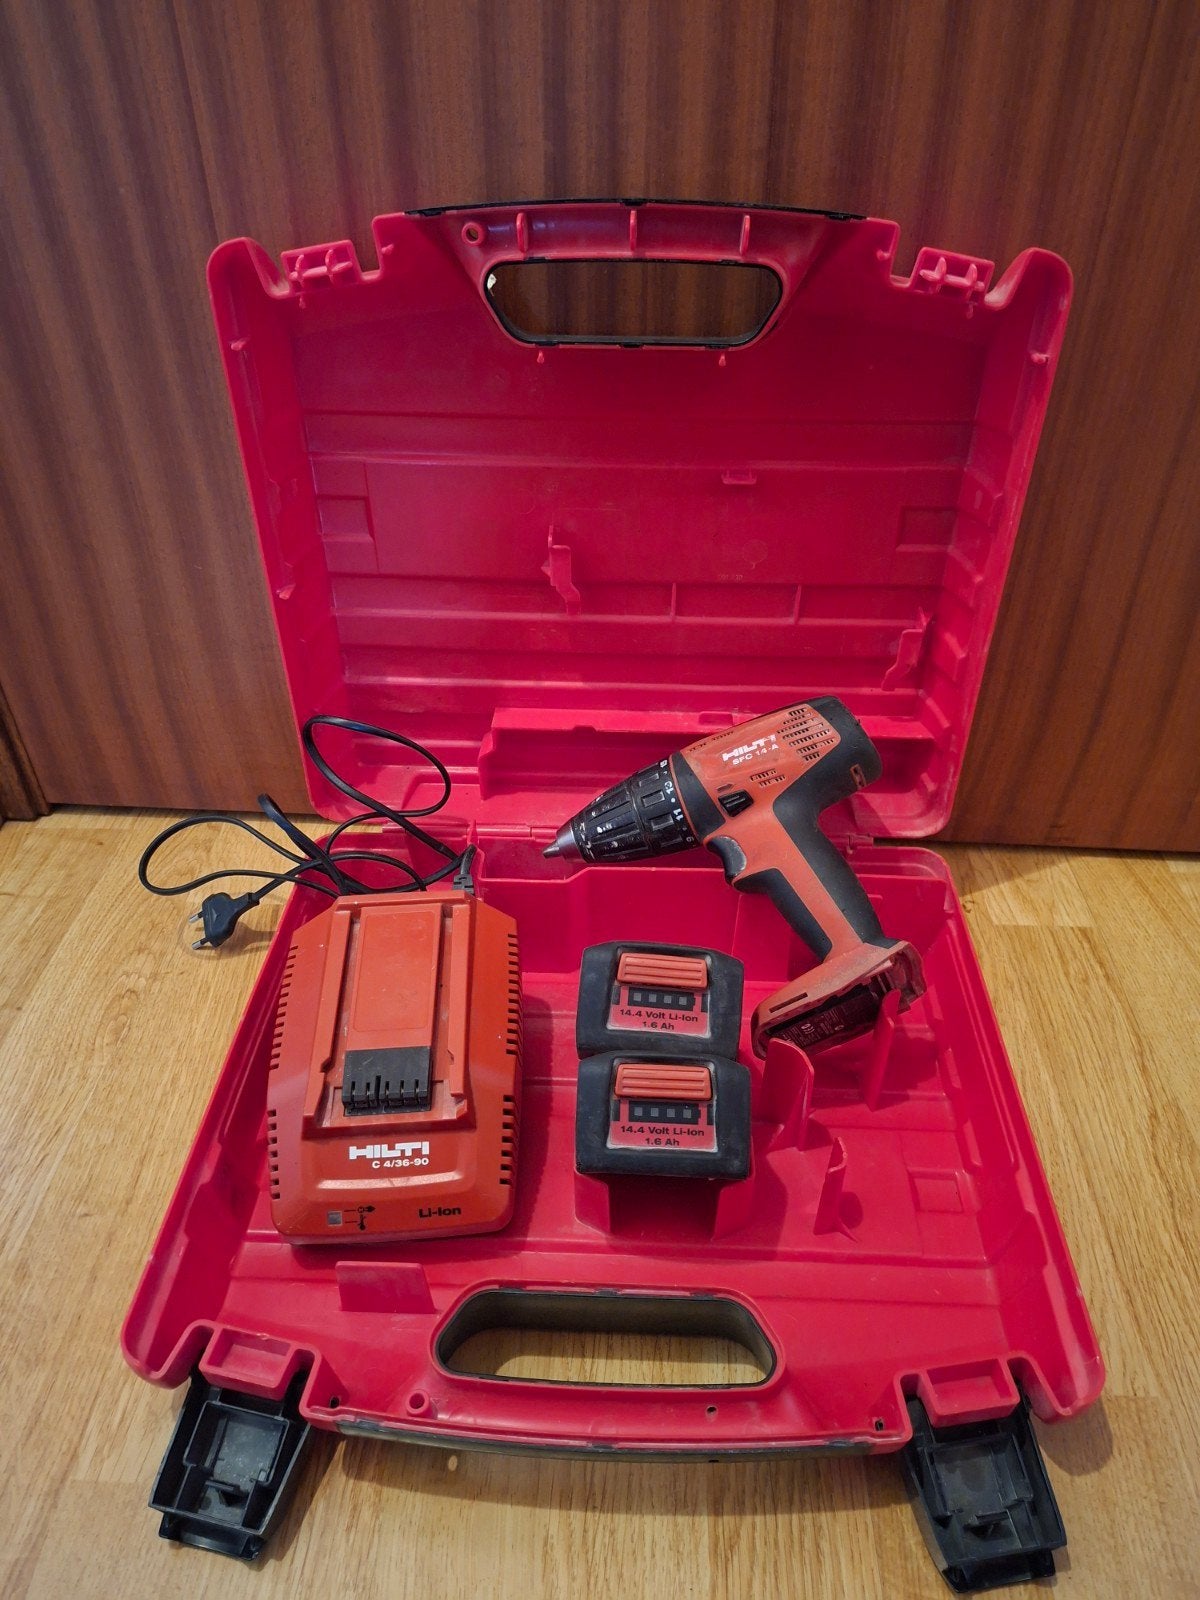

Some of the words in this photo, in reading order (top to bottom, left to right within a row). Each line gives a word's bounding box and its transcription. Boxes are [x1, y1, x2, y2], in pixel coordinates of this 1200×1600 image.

[722, 734, 776, 761] HILTI
[732, 753, 753, 765] SFC
[755, 744, 779, 756] 14-A
[673, 808, 684, 821] 11
[620, 1008, 643, 1018] 14.4
[646, 1010, 665, 1020] Volt
[669, 1012, 698, 1022] Li-Ion
[642, 1021, 658, 1029] 1.6
[660, 1021, 675, 1030] Ah
[620, 1125, 645, 1134] 14.4
[648, 1126, 670, 1135] Volt
[673, 1127, 705, 1136] Li-Ion
[645, 1137, 662, 1146] 1.6
[664, 1138, 680, 1147] Ah
[349, 1141, 430, 1160] HILTI
[371, 1160, 381, 1169] C
[383, 1157, 429, 1168] 4/36-90
[418, 1206, 462, 1219] Li-Ion
